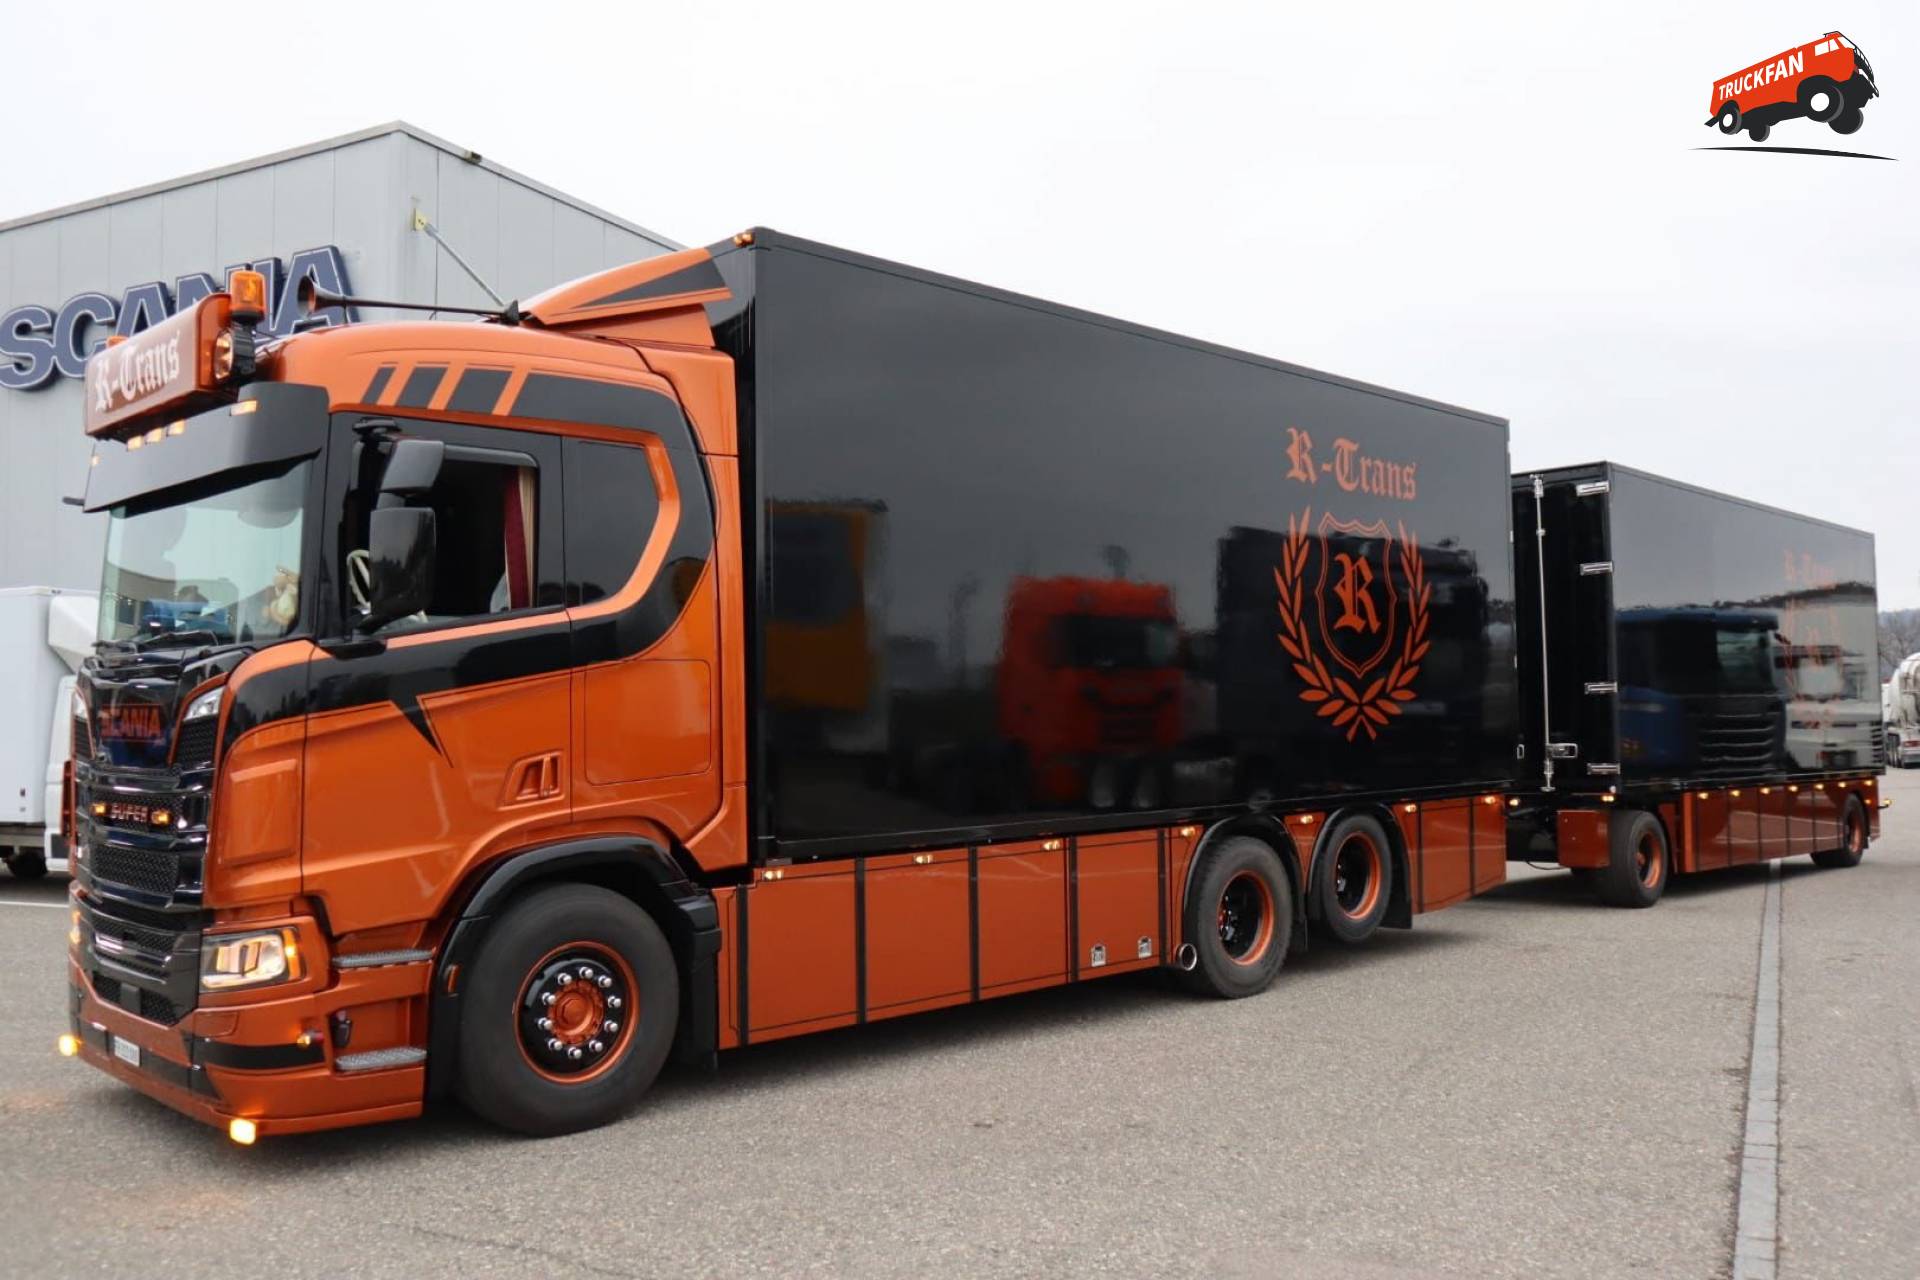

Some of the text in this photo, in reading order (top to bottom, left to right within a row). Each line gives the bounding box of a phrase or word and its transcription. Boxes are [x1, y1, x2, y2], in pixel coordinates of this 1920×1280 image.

[1285, 426, 1418, 501] R-Trans
[1333, 552, 1381, 634] R
[111, 801, 149, 822] SUPER
